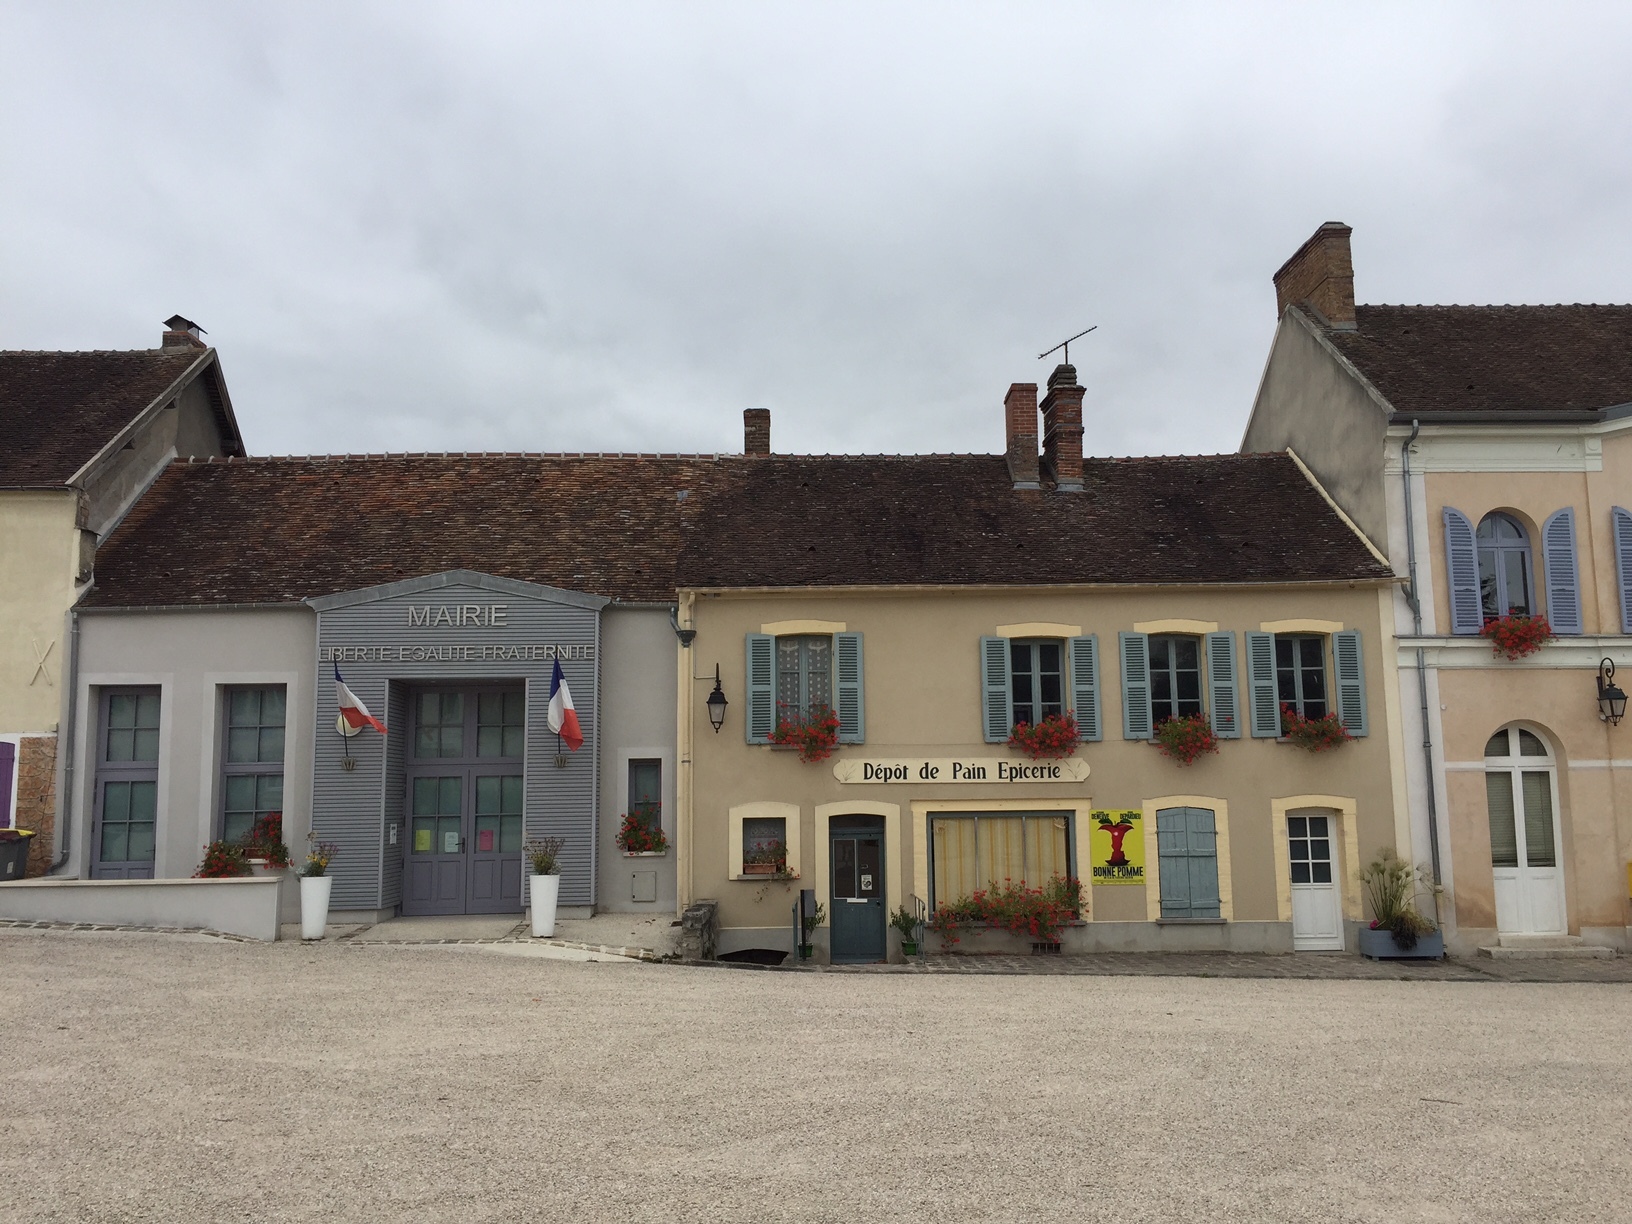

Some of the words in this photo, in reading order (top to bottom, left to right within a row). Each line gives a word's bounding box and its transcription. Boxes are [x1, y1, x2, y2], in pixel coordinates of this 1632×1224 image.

[408, 604, 508, 627] MAIRIE
[863, 761, 909, 783] Dépôt
[919, 762, 940, 779] de
[952, 762, 987, 780] Pain
[998, 761, 1061, 783] Epicerie
[1094, 866, 1116, 876] BONNE
[1118, 866, 1143, 876] POMME
